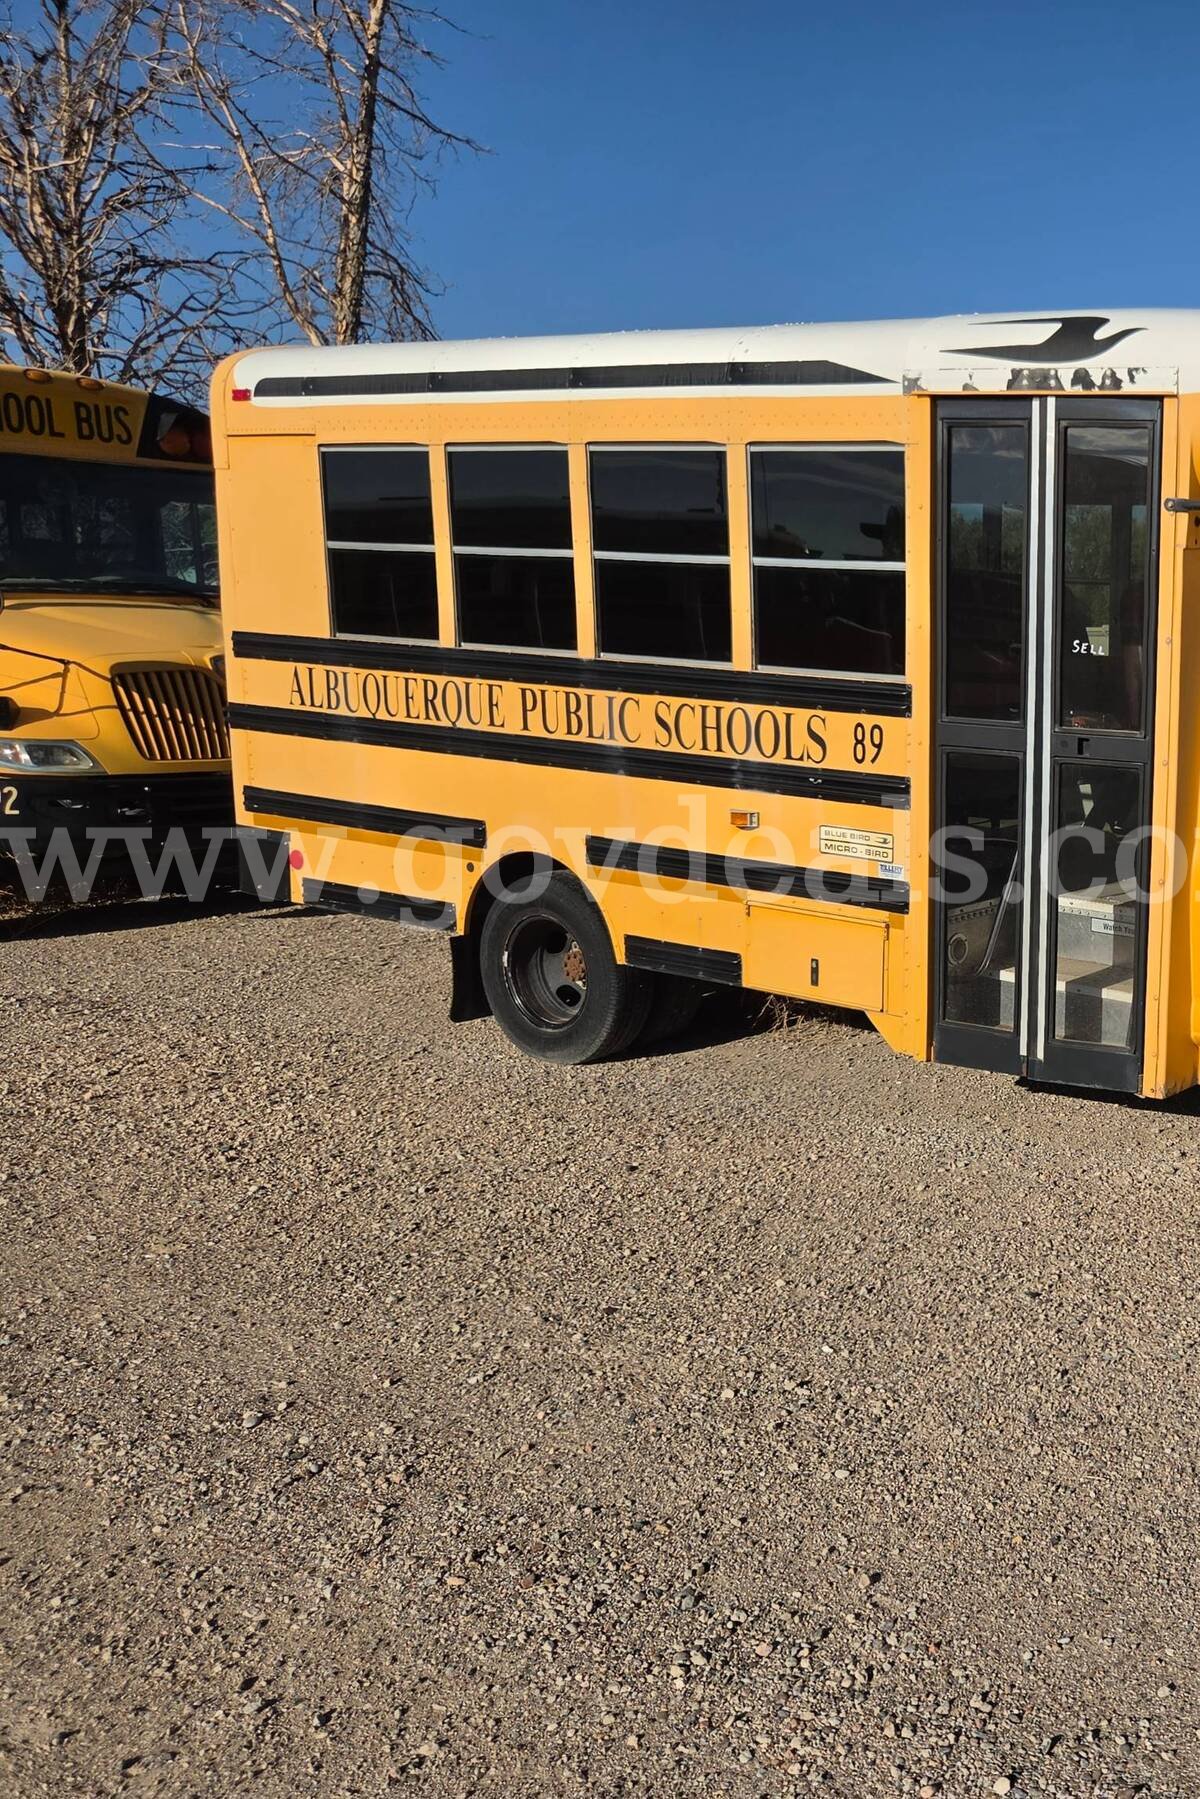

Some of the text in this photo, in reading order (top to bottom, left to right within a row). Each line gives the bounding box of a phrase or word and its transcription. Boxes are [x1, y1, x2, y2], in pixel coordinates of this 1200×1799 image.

[0, 393, 133, 445] OOL BUS
[1072, 640, 1105, 656] SELL
[289, 665, 884, 764] ALBUQUERQUE PUBLIC SCHOOLS 89
[0, 786, 20, 815] 2
[824, 829, 870, 841] BLUE BIRD
[1103, 922, 1122, 932] Watch
